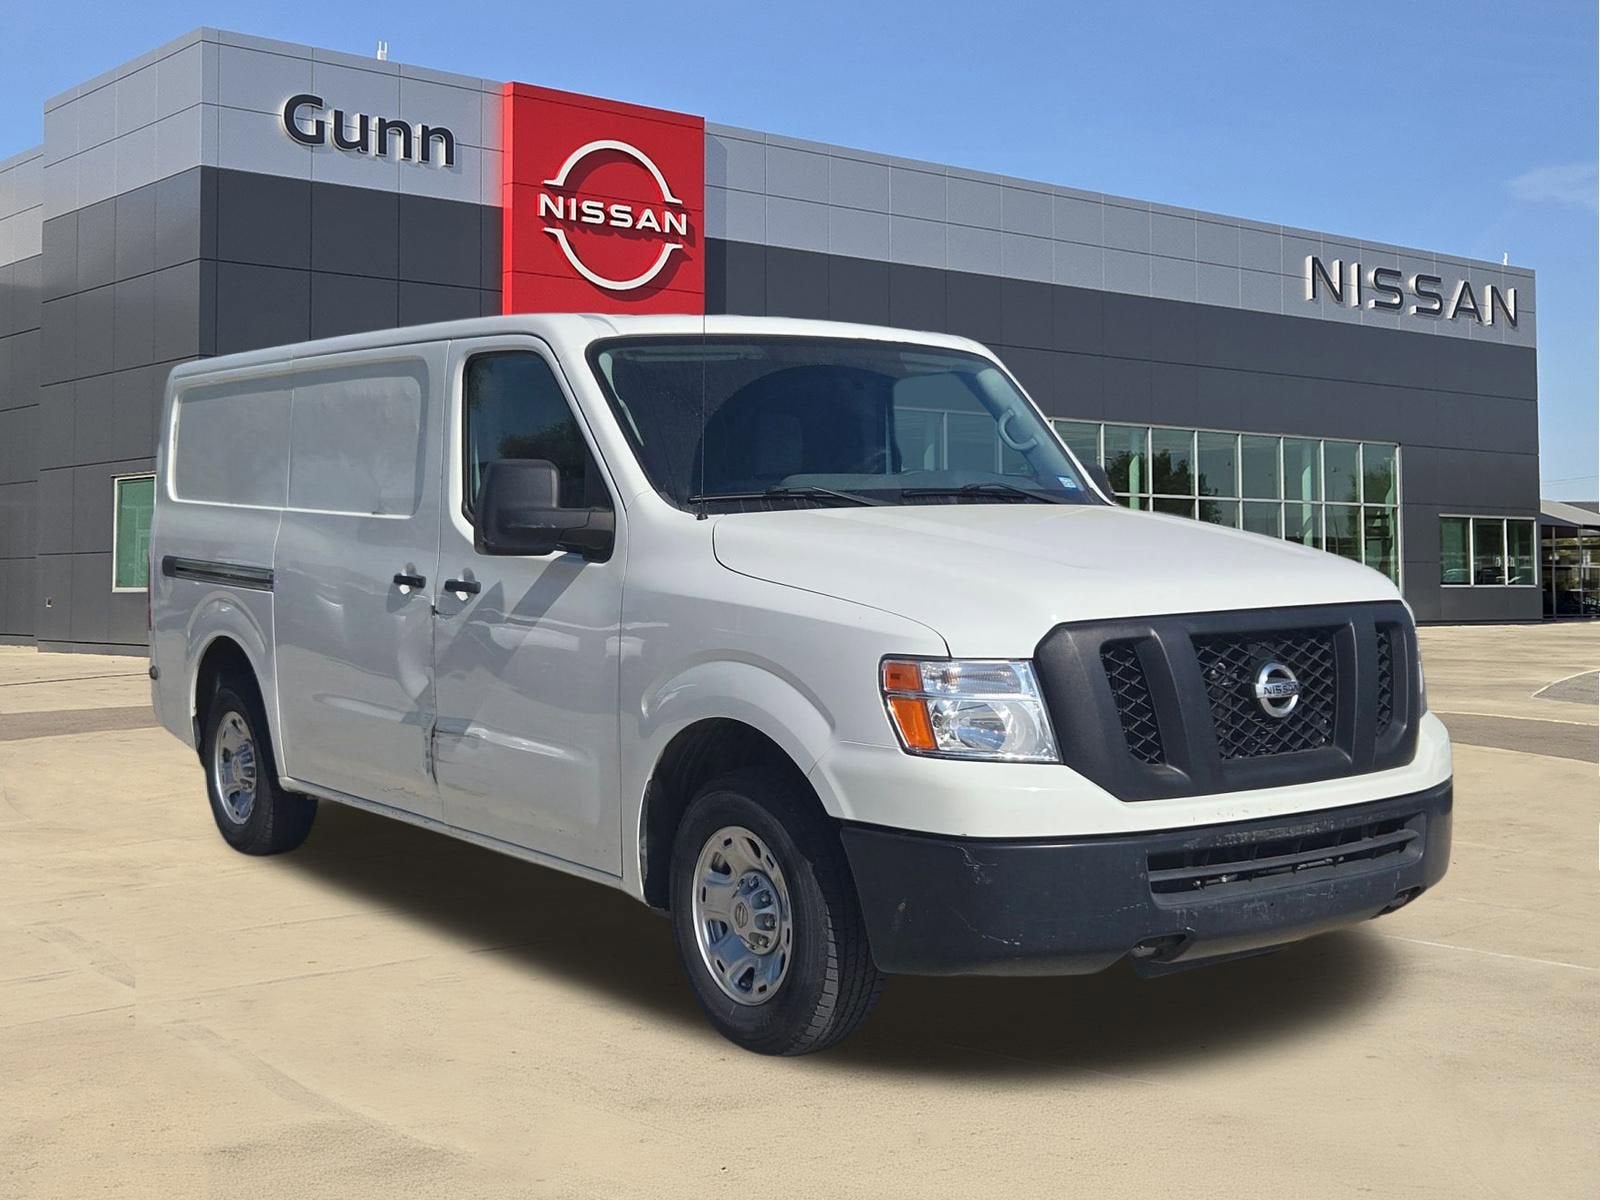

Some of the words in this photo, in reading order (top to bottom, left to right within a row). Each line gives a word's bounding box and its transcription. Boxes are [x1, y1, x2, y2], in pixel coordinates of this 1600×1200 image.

[282, 94, 455, 167] Gunn
[538, 193, 687, 235] NISSAN
[1305, 255, 1518, 327] NISSAN
